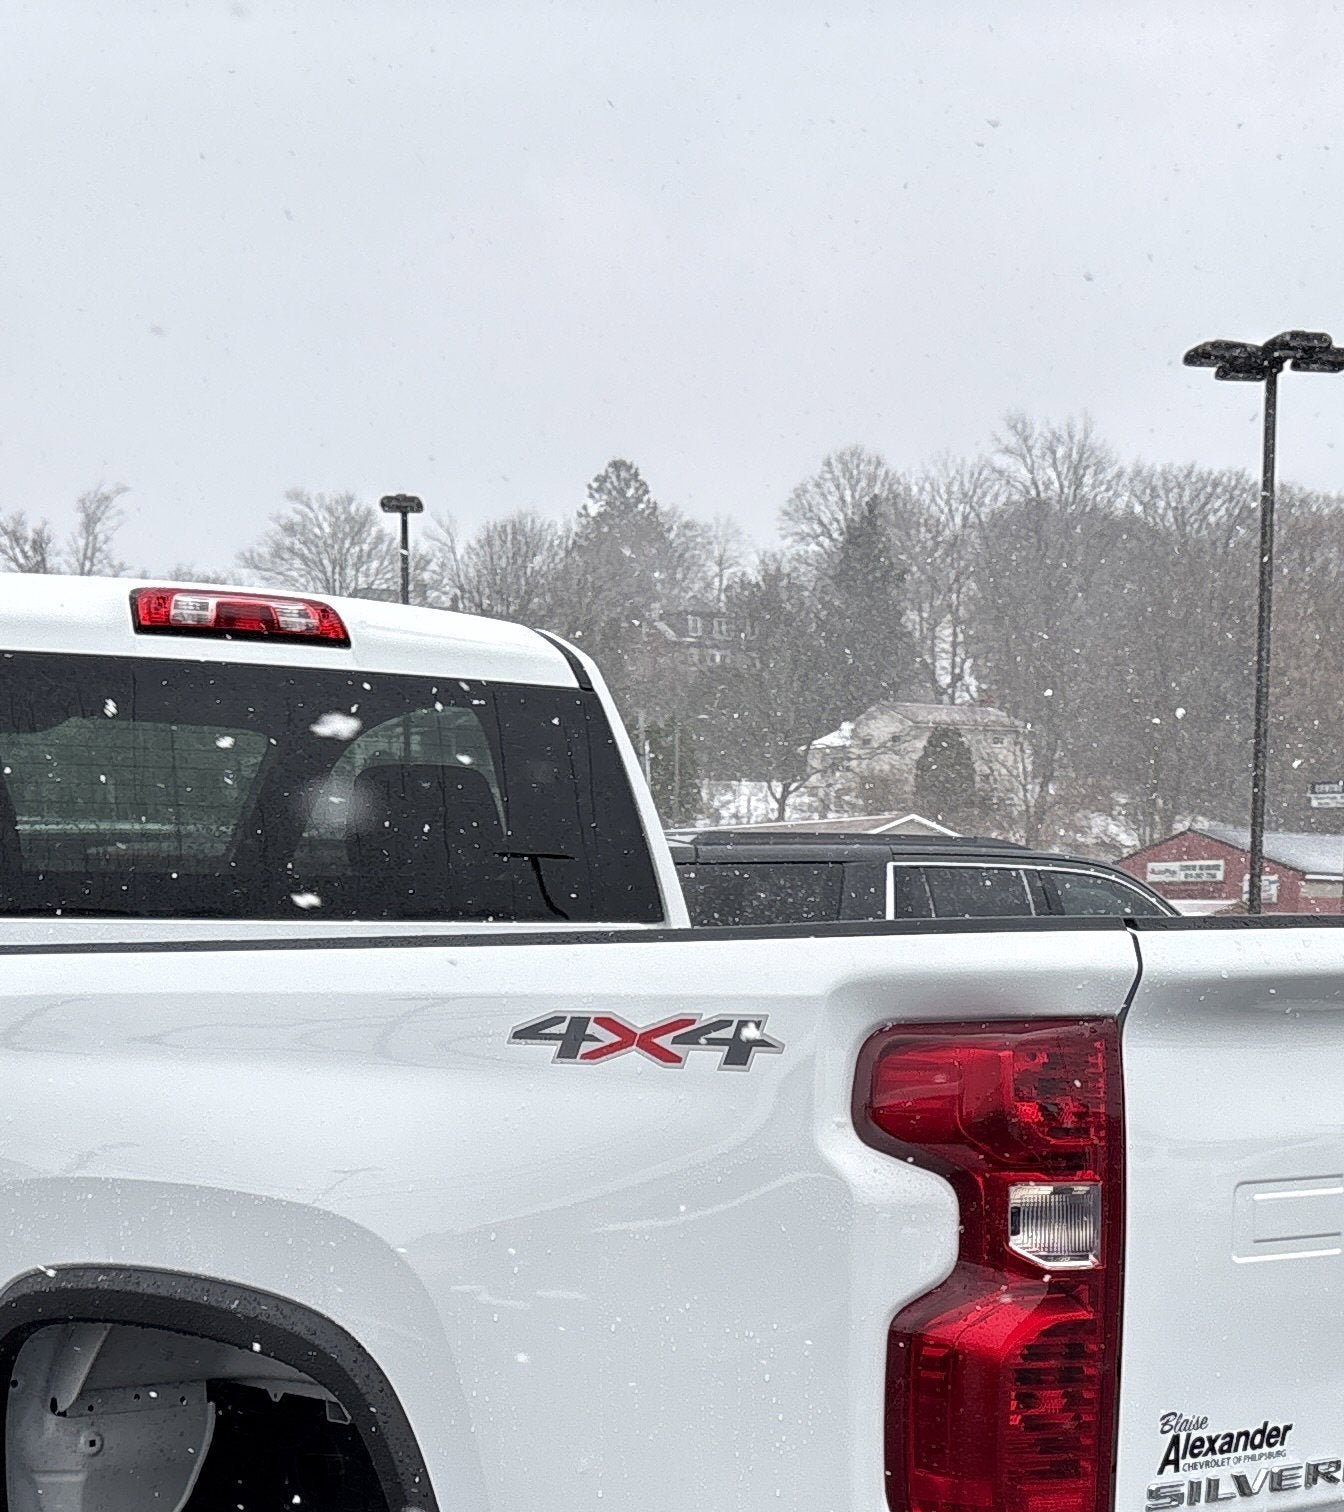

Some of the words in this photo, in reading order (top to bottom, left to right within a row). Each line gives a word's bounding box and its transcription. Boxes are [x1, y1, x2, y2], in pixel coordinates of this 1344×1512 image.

[1159, 1411, 1209, 1434] Blaise
[1157, 1420, 1294, 1475] Alexander
[1182, 1456, 1231, 1473] CHEVROLET
[1233, 1454, 1244, 1465] OF
